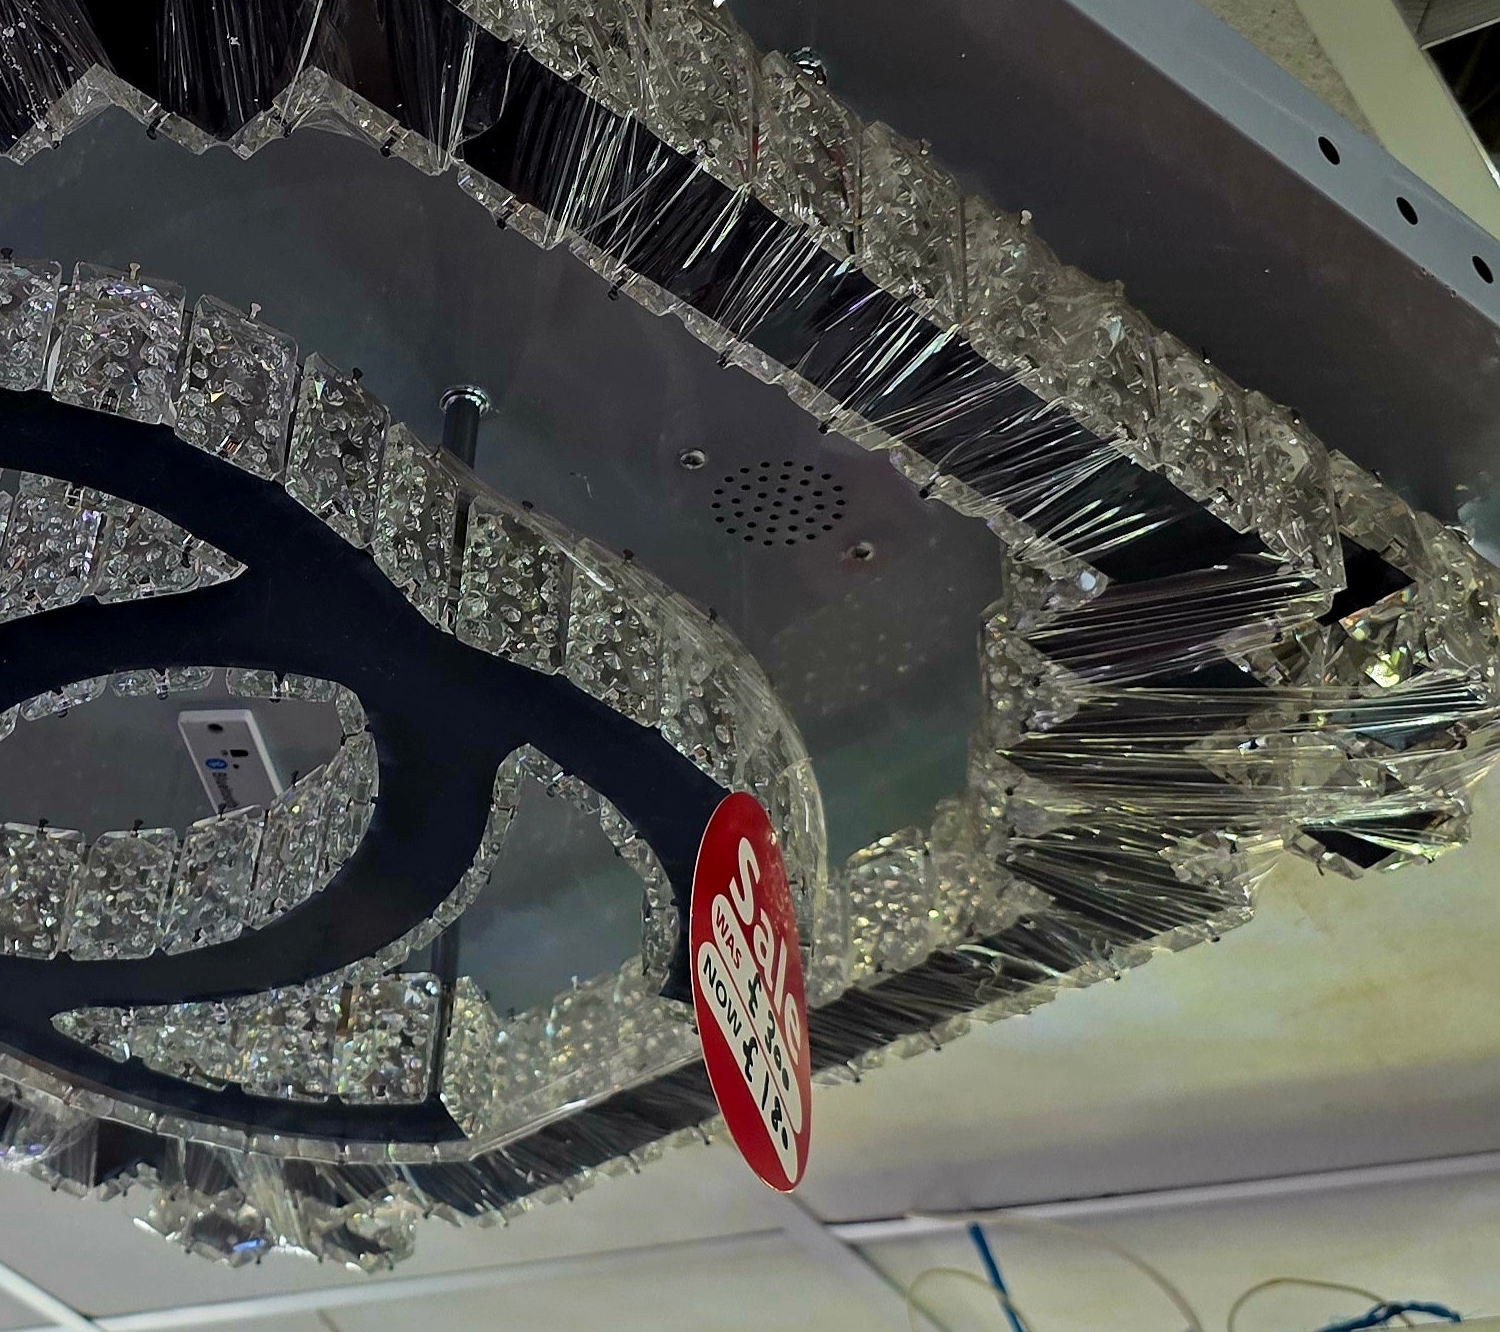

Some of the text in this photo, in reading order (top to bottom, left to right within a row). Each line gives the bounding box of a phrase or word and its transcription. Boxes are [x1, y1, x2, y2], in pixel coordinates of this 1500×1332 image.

[715, 904, 743, 970] WAS
[730, 836, 802, 1065] Sale
[703, 953, 743, 1038] NOW
